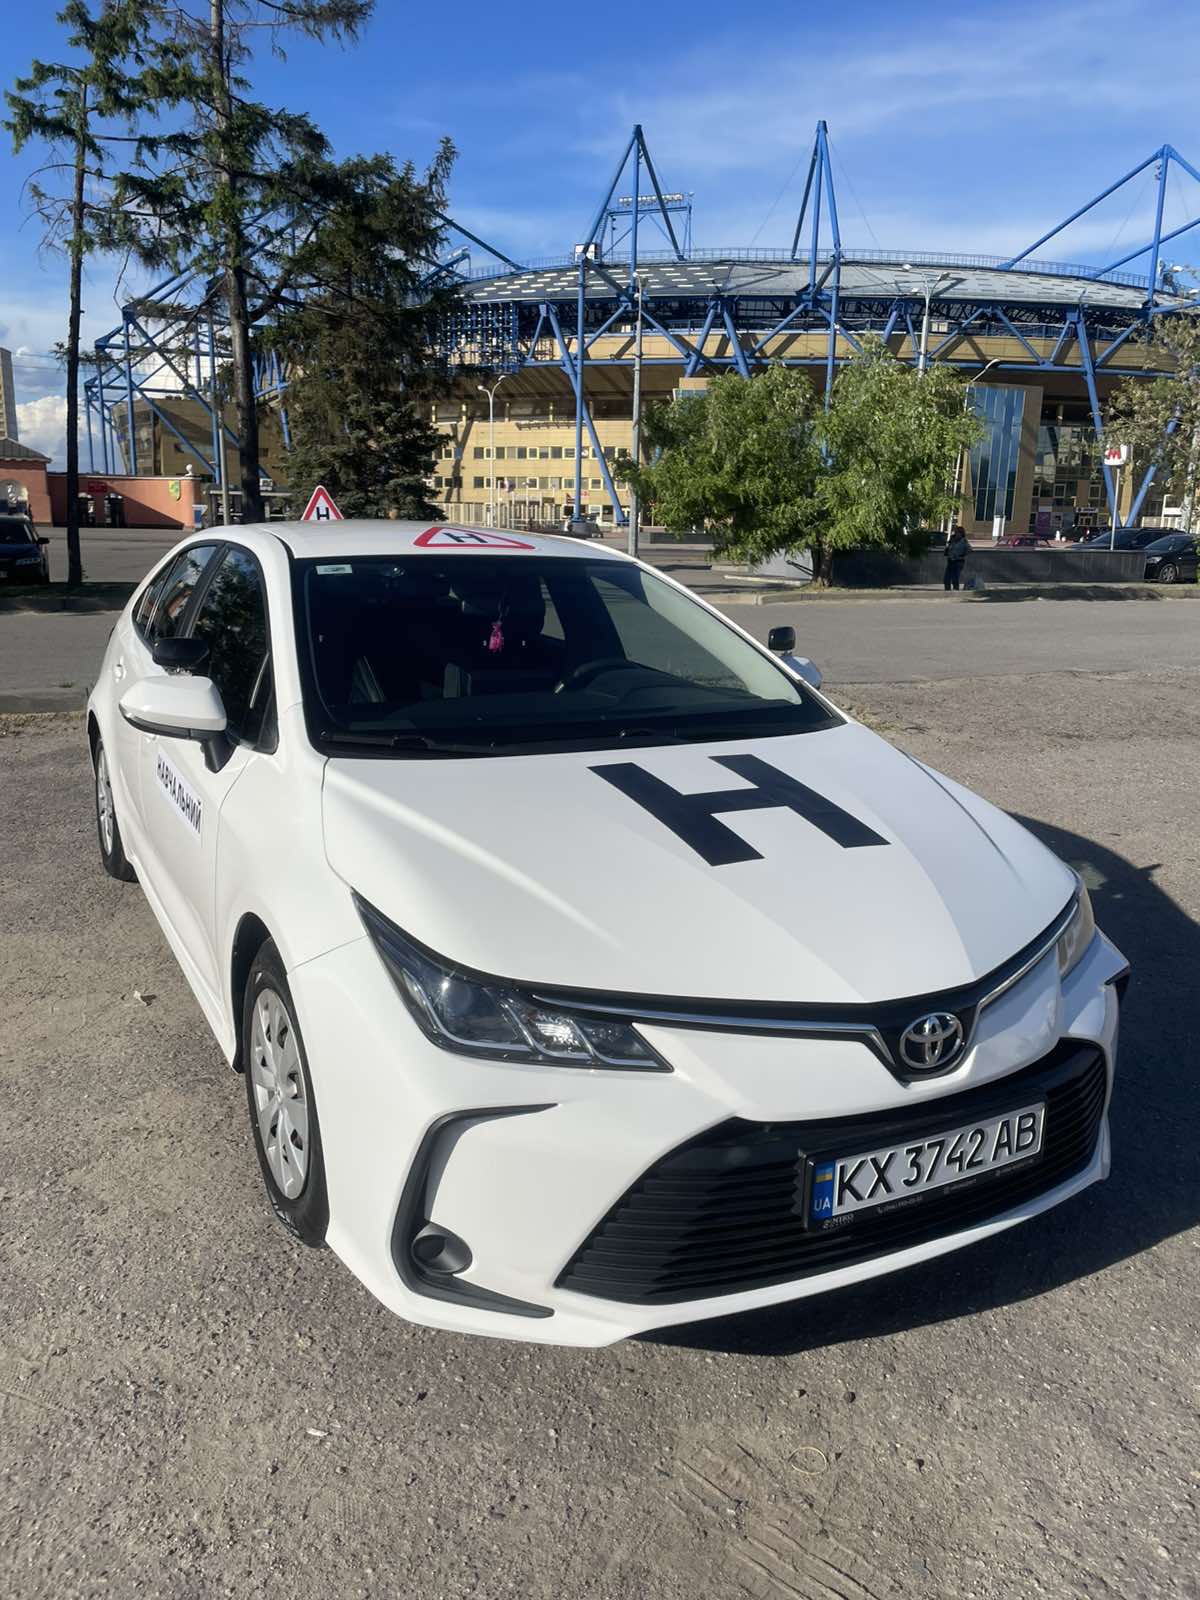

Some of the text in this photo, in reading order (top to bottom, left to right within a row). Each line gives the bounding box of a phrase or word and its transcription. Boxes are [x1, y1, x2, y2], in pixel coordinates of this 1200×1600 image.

[157, 755, 201, 834] НАВЧАЛЬНИЙ
[586, 753, 892, 867] Н
[836, 1112, 1037, 1207] KX 3742 AB
[814, 1197, 831, 1211] UA
